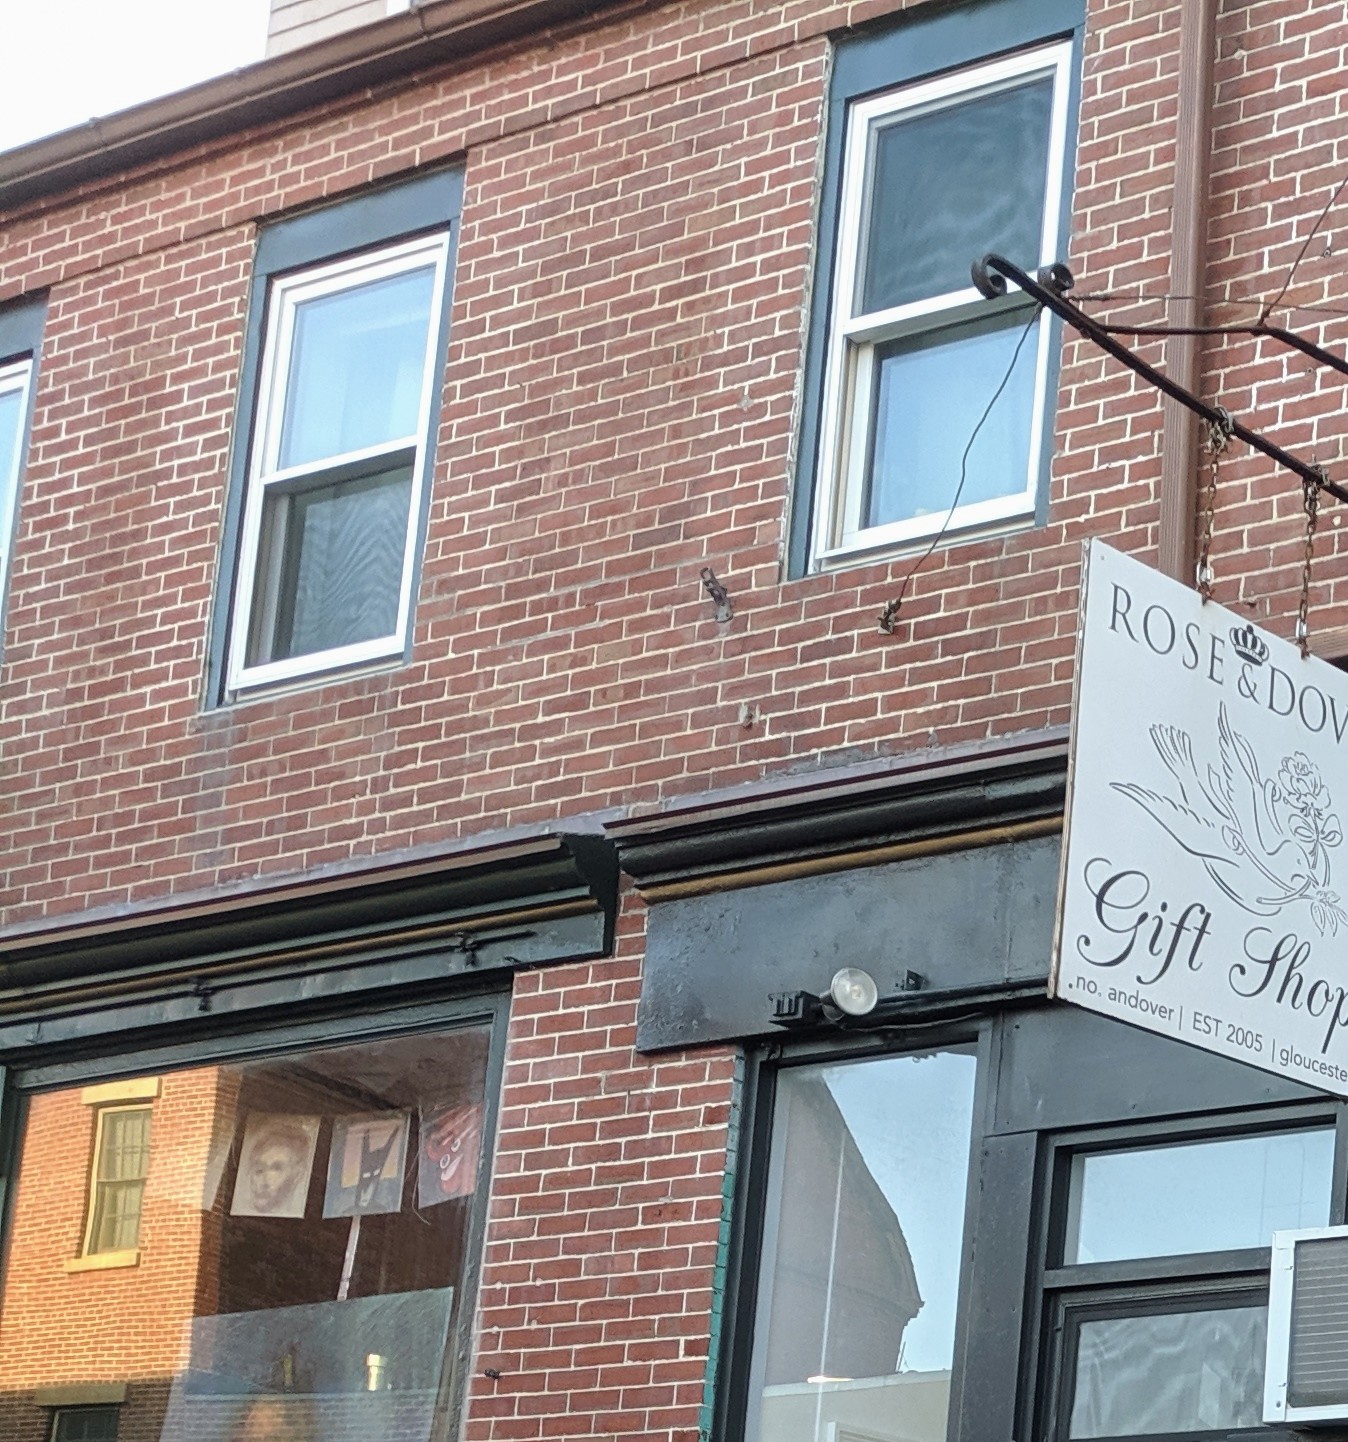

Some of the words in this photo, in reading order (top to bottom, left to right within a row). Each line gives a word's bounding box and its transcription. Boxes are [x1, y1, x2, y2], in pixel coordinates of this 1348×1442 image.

[1107, 581, 1226, 687] ROSE
[1076, 856, 1213, 985] Gift
[1192, 1011, 1222, 1038] EST
[1226, 1023, 1263, 1052] 2005
